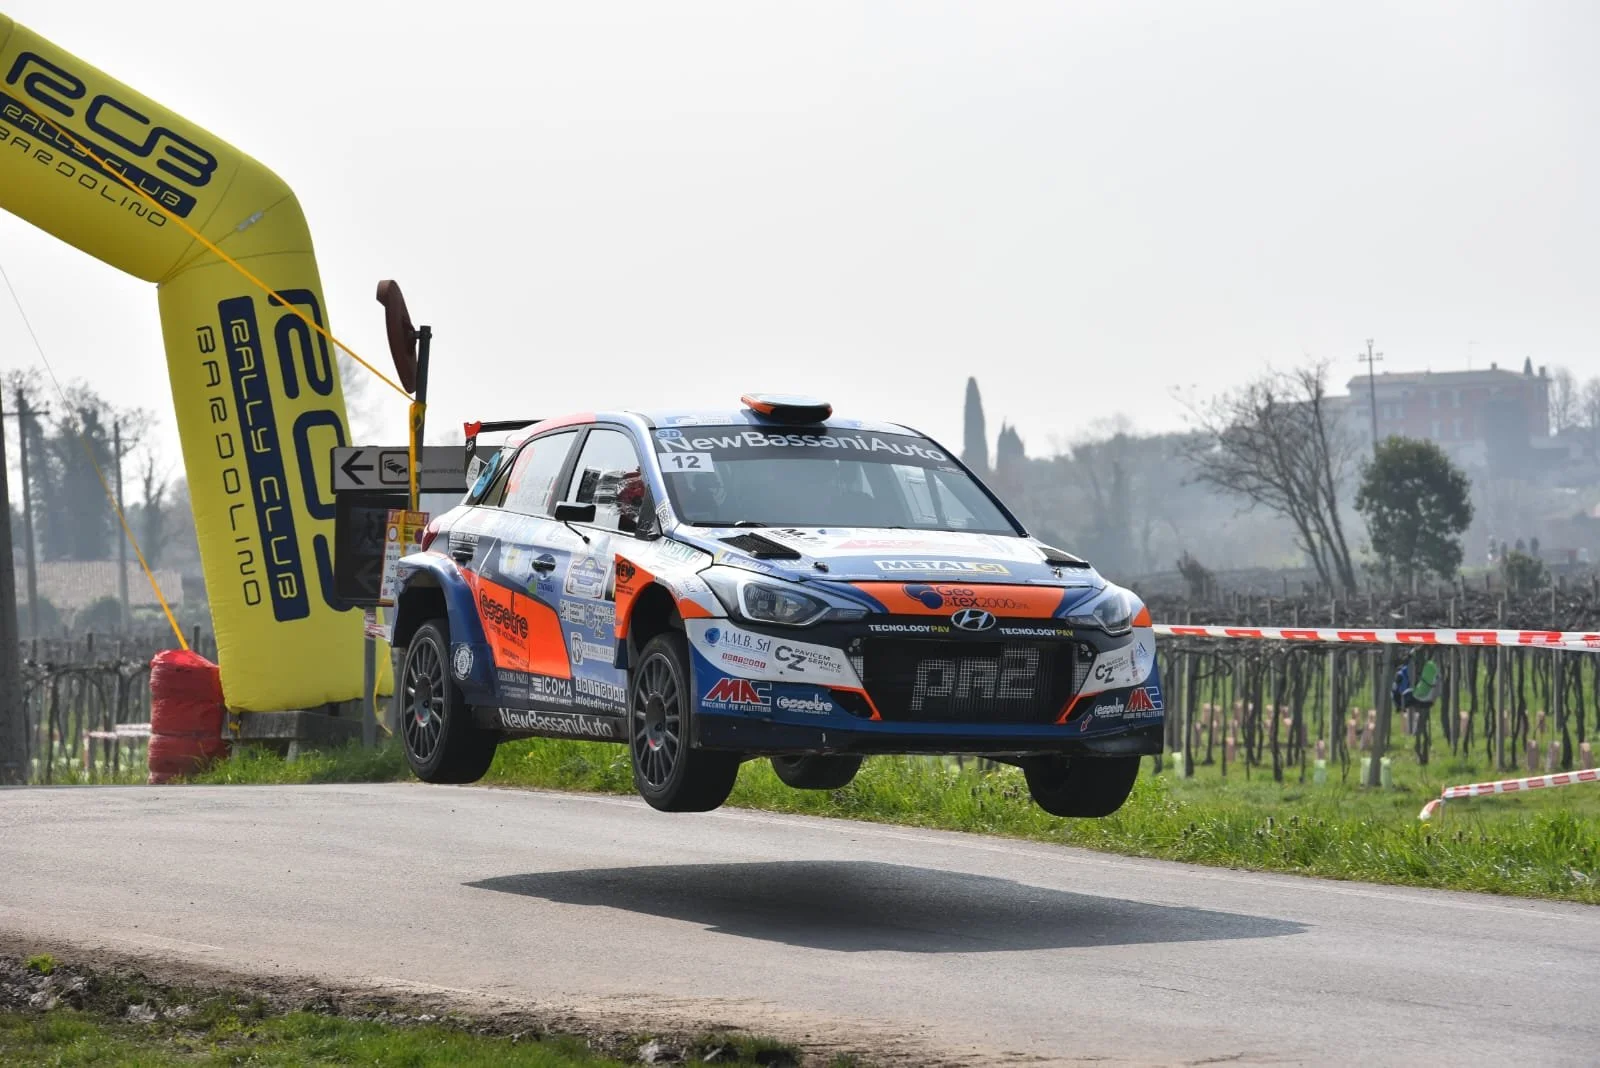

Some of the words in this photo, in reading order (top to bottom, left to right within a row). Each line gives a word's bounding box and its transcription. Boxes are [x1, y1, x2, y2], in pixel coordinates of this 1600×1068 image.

[2, 104, 92, 158] RALLY
[102, 157, 182, 207] CLUB
[230, 318, 272, 455] RALLY
[259, 474, 299, 600] CLUB
[658, 431, 947, 462] NewBassaniAuto
[195, 325, 262, 607] BARDOLINO
[671, 455, 701, 469] 12
[936, 585, 974, 597] Geo
[774, 644, 805, 673] CZ
[794, 647, 831, 662] PAVICEM
[807, 656, 843, 670] SERVICE
[1095, 663, 1115, 684] CZ
[541, 676, 573, 698] ICOMA
[498, 708, 614, 738] NewBassaniAuto
